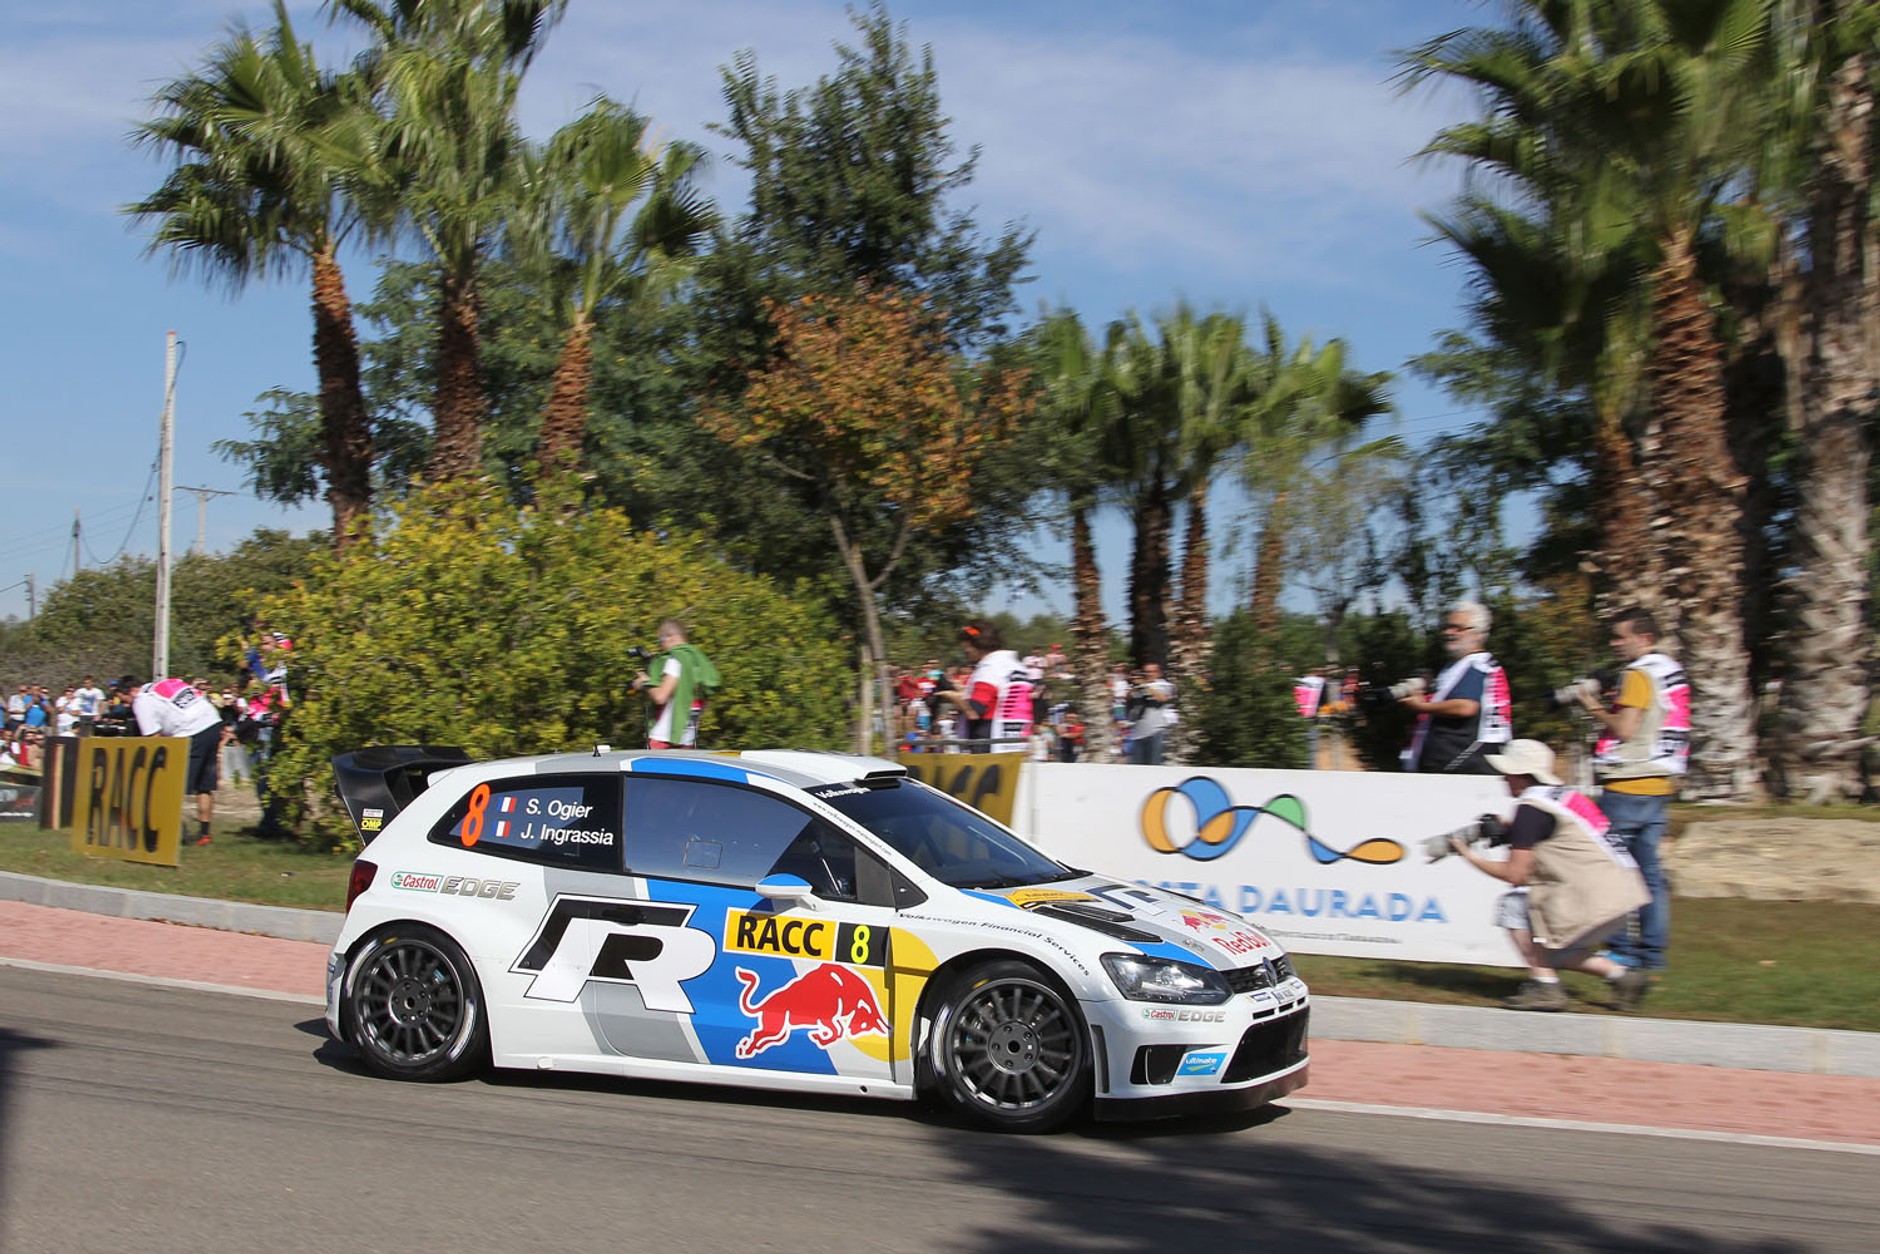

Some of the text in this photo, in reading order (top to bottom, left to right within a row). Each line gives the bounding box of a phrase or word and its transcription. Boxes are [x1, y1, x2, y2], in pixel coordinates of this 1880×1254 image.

[86, 746, 168, 853] RACC
[461, 783, 491, 848] 8
[526, 798, 593, 821] S. Ogier
[361, 819, 382, 829] OMP
[520, 822, 614, 846] J. Ingrassia
[402, 874, 521, 901] Castrol EDGE
[1240, 884, 1449, 924] DAURADA
[508, 892, 717, 1014] R
[736, 915, 871, 964] RACC 8
[900, 912, 1090, 977] Volkswagen Financial Services
[1150, 1009, 1226, 1023] Castrol EDGE
[1186, 1056, 1218, 1065] ultimate
